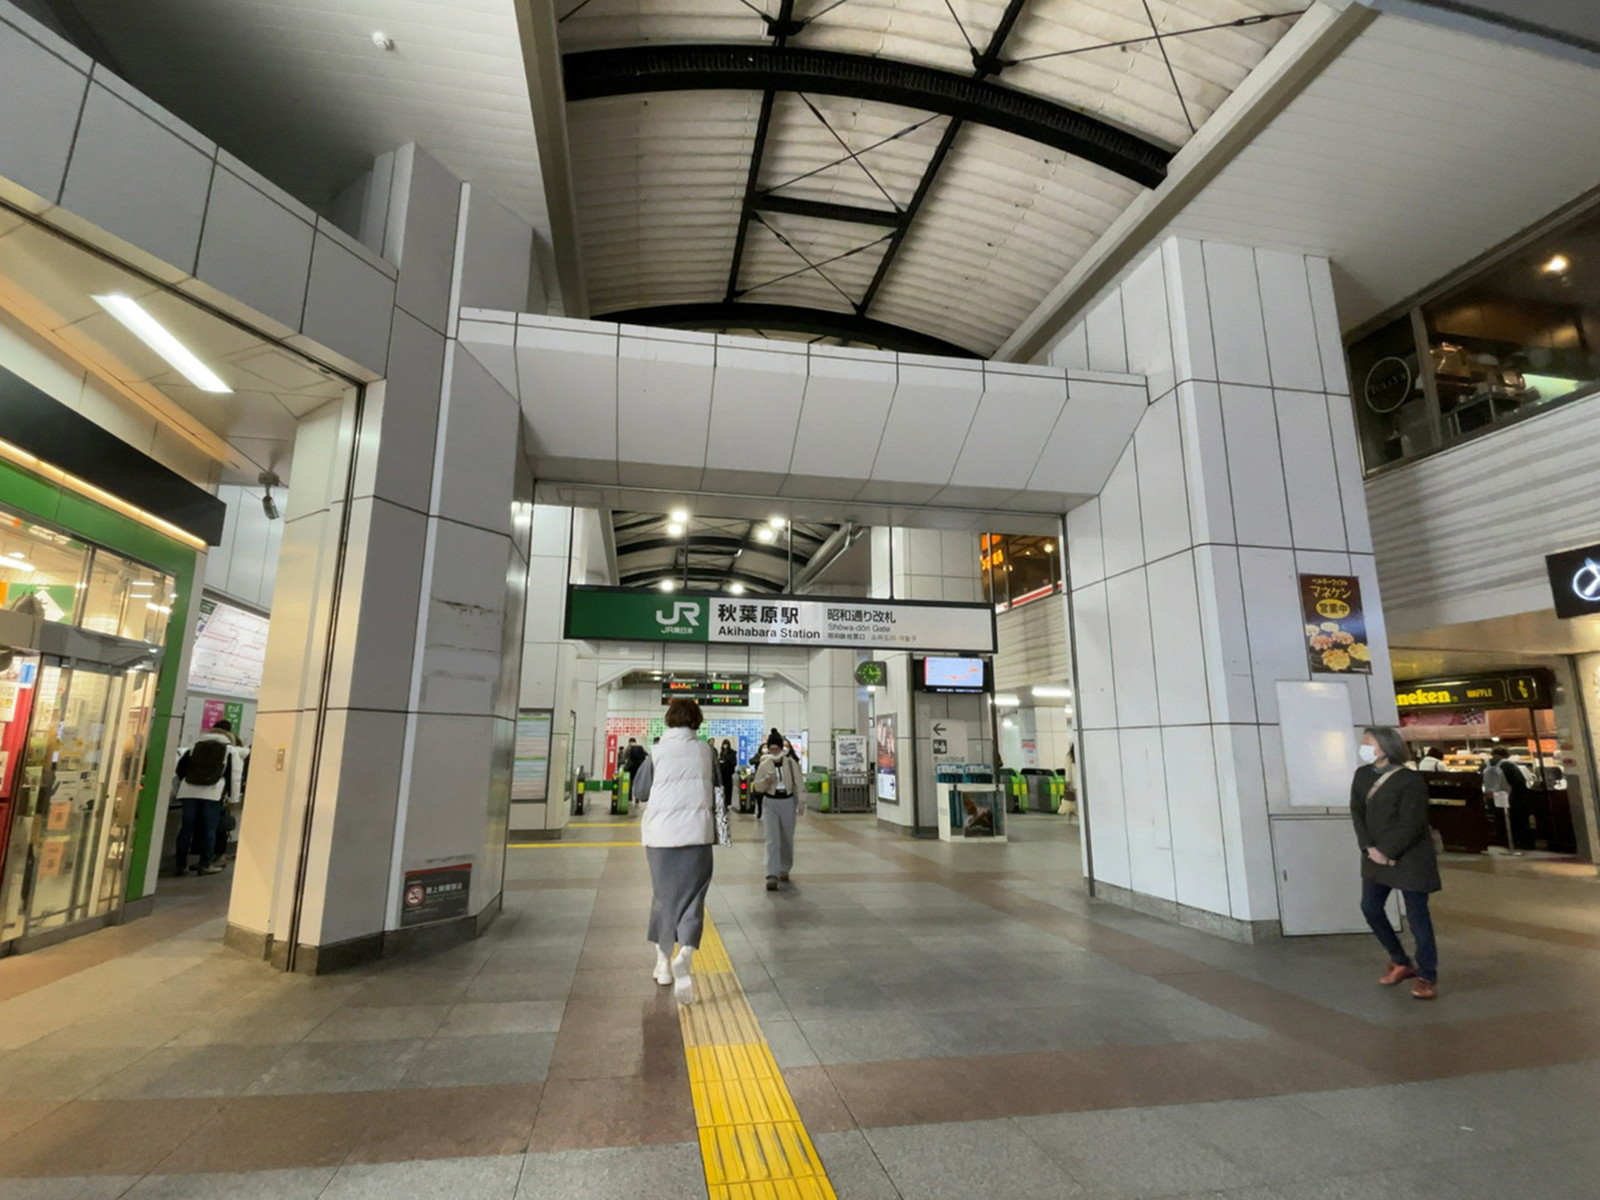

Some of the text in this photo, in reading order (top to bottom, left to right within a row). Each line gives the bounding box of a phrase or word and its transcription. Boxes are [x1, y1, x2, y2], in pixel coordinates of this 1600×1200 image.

[1309, 585, 1352, 599] マネケン
[656, 601, 700, 626] JR
[717, 603, 799, 625] 秋葉原駅
[827, 608, 896, 624] 昭和通り改札
[718, 626, 821, 640] Akihabara Station
[872, 624, 891, 633] Gate
